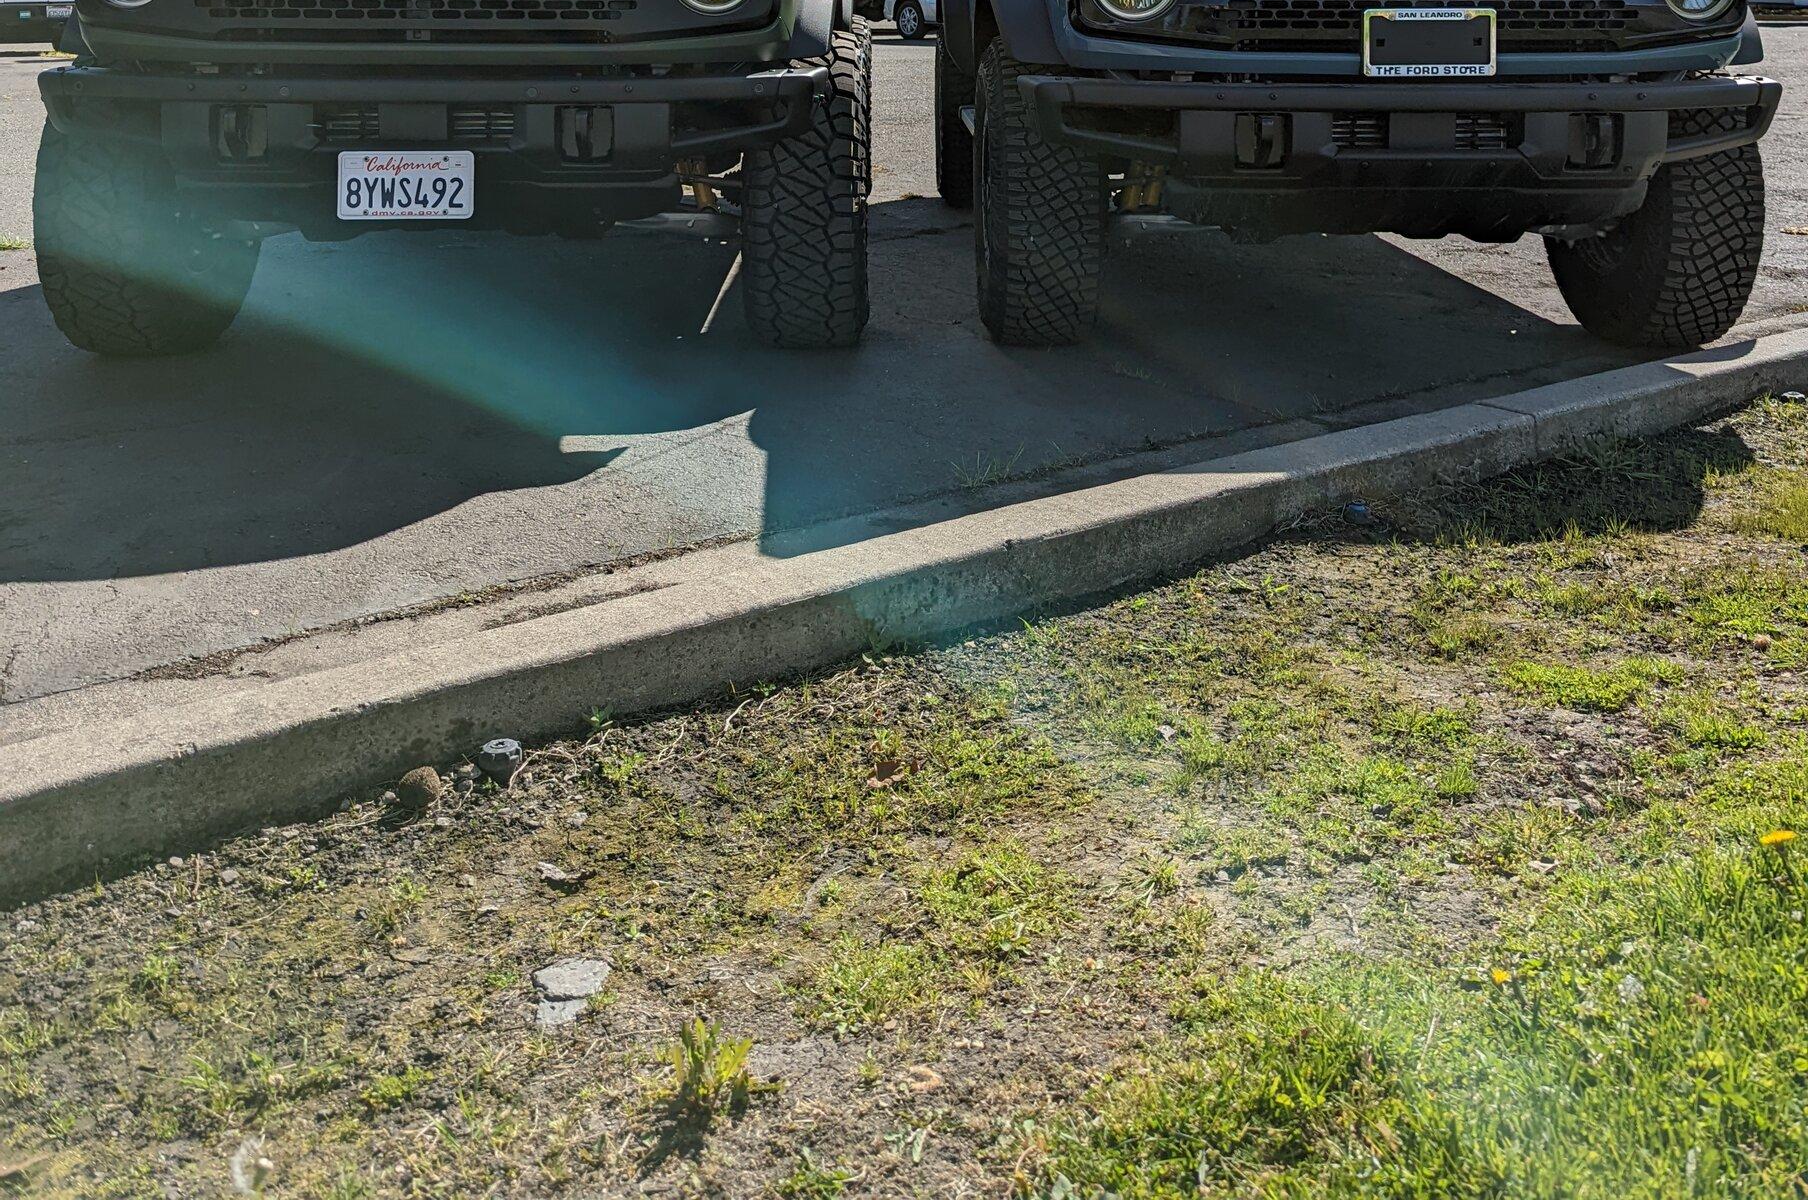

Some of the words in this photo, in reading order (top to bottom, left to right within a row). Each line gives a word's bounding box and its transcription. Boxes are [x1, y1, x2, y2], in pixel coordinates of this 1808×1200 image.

[1376, 66, 1401, 75] THE
[1406, 66, 1439, 75] FORD
[1443, 66, 1486, 75] STORE
[366, 156, 449, 176] California
[346, 177, 464, 209] 8YWS492
[371, 209, 440, 217] dmv.ca.gov
